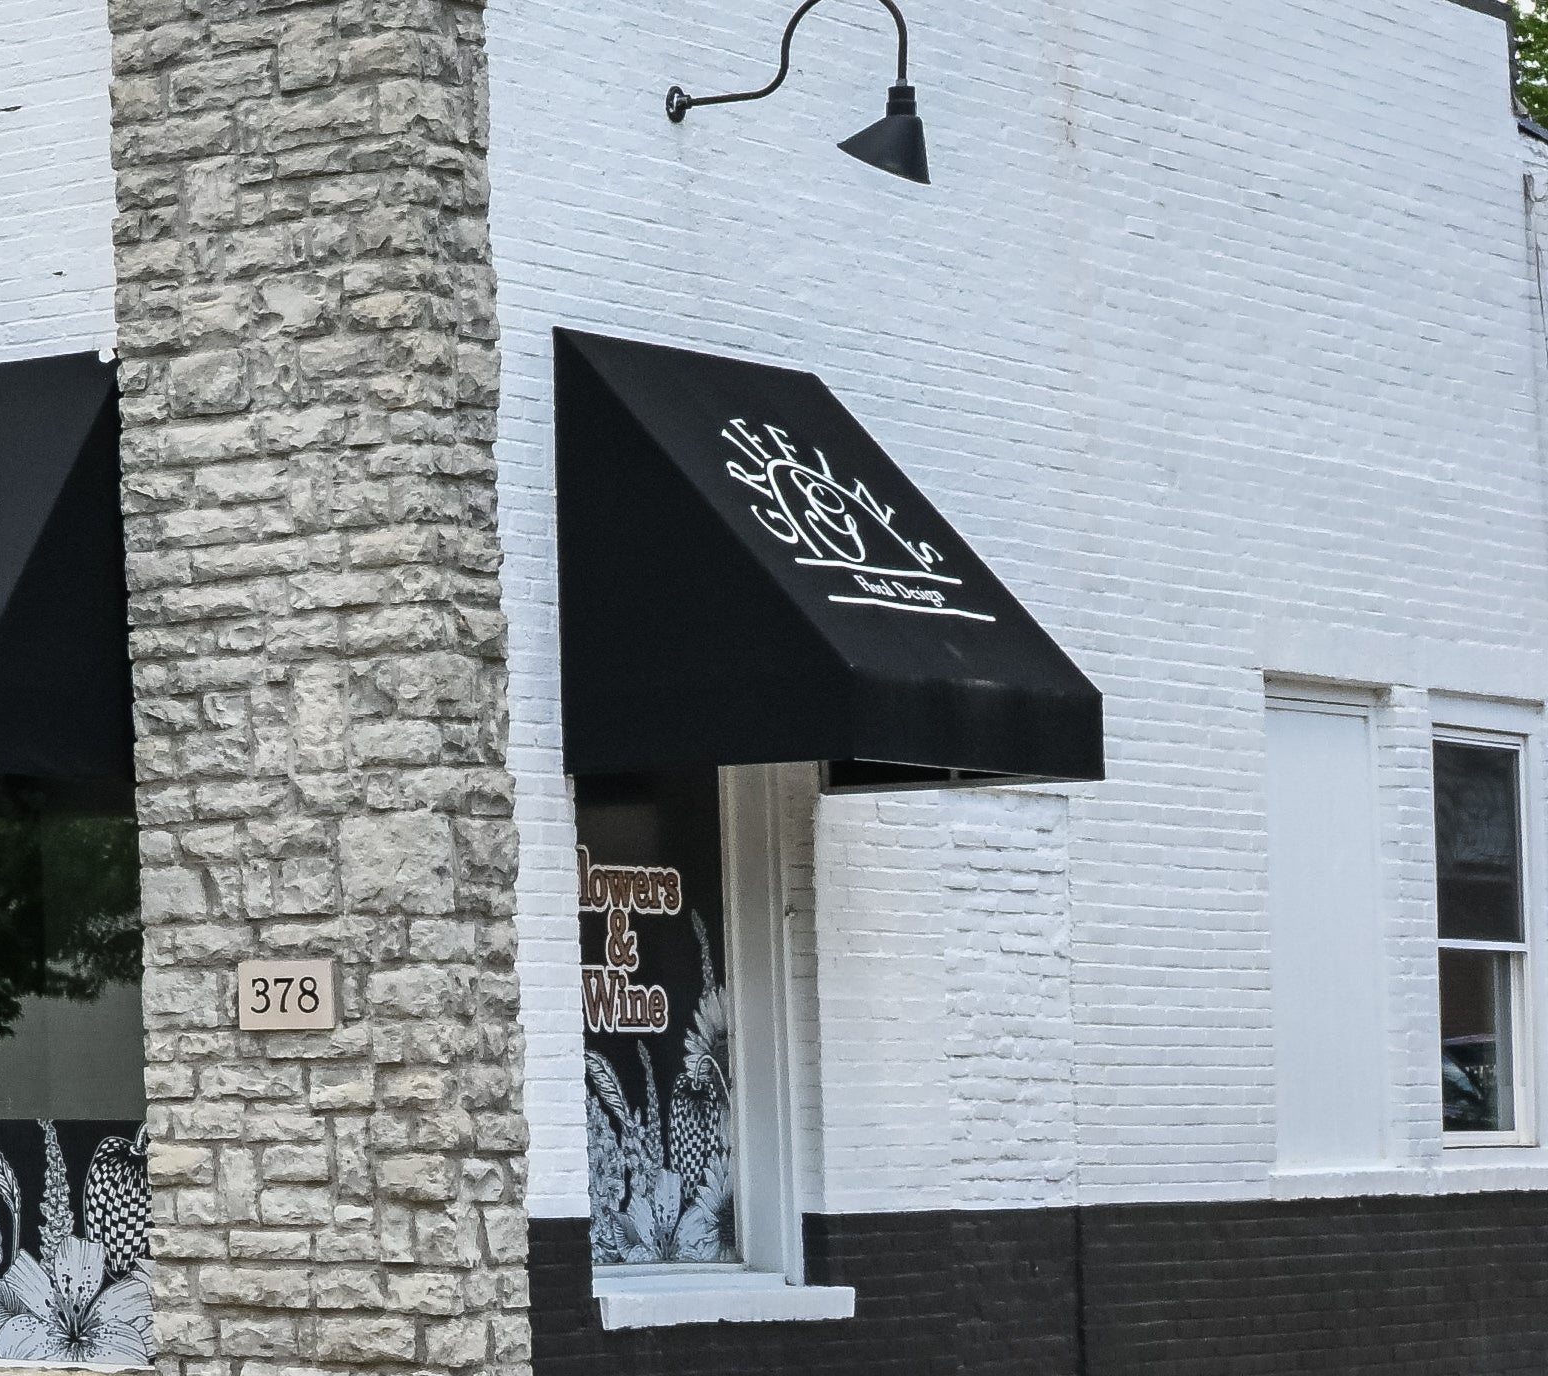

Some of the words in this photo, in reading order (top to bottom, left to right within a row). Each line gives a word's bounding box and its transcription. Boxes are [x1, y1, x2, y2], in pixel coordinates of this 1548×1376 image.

[721, 418, 944, 565] GRIFFINS
[853, 574, 897, 597] Floral
[893, 581, 946, 608] Design
[576, 844, 682, 915] lowers
[607, 908, 640, 972] &
[250, 976, 320, 1014] 378
[581, 965, 669, 1033] Wine
